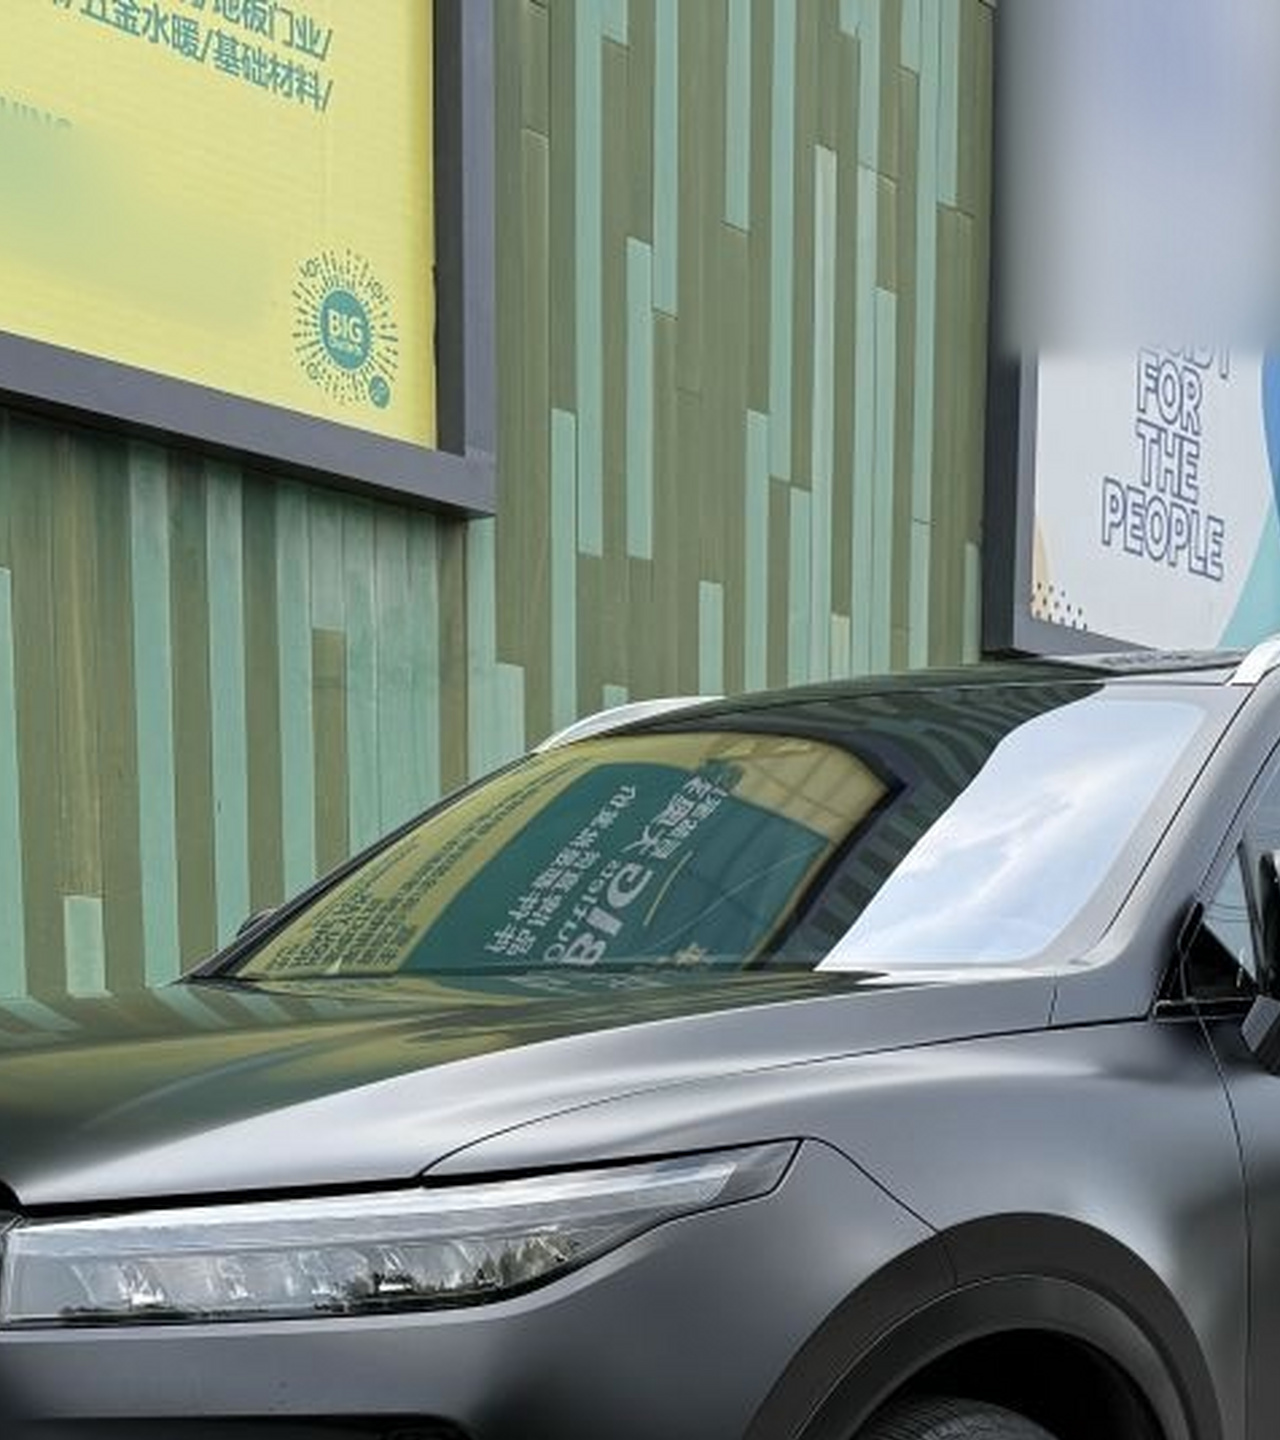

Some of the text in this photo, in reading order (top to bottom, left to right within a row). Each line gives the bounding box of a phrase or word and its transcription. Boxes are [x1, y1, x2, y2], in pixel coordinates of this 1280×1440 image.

[328, 309, 363, 344] BIG
[1136, 347, 1204, 437] FOR
[1136, 417, 1200, 508] THE
[1101, 475, 1225, 581] PEOPLE
